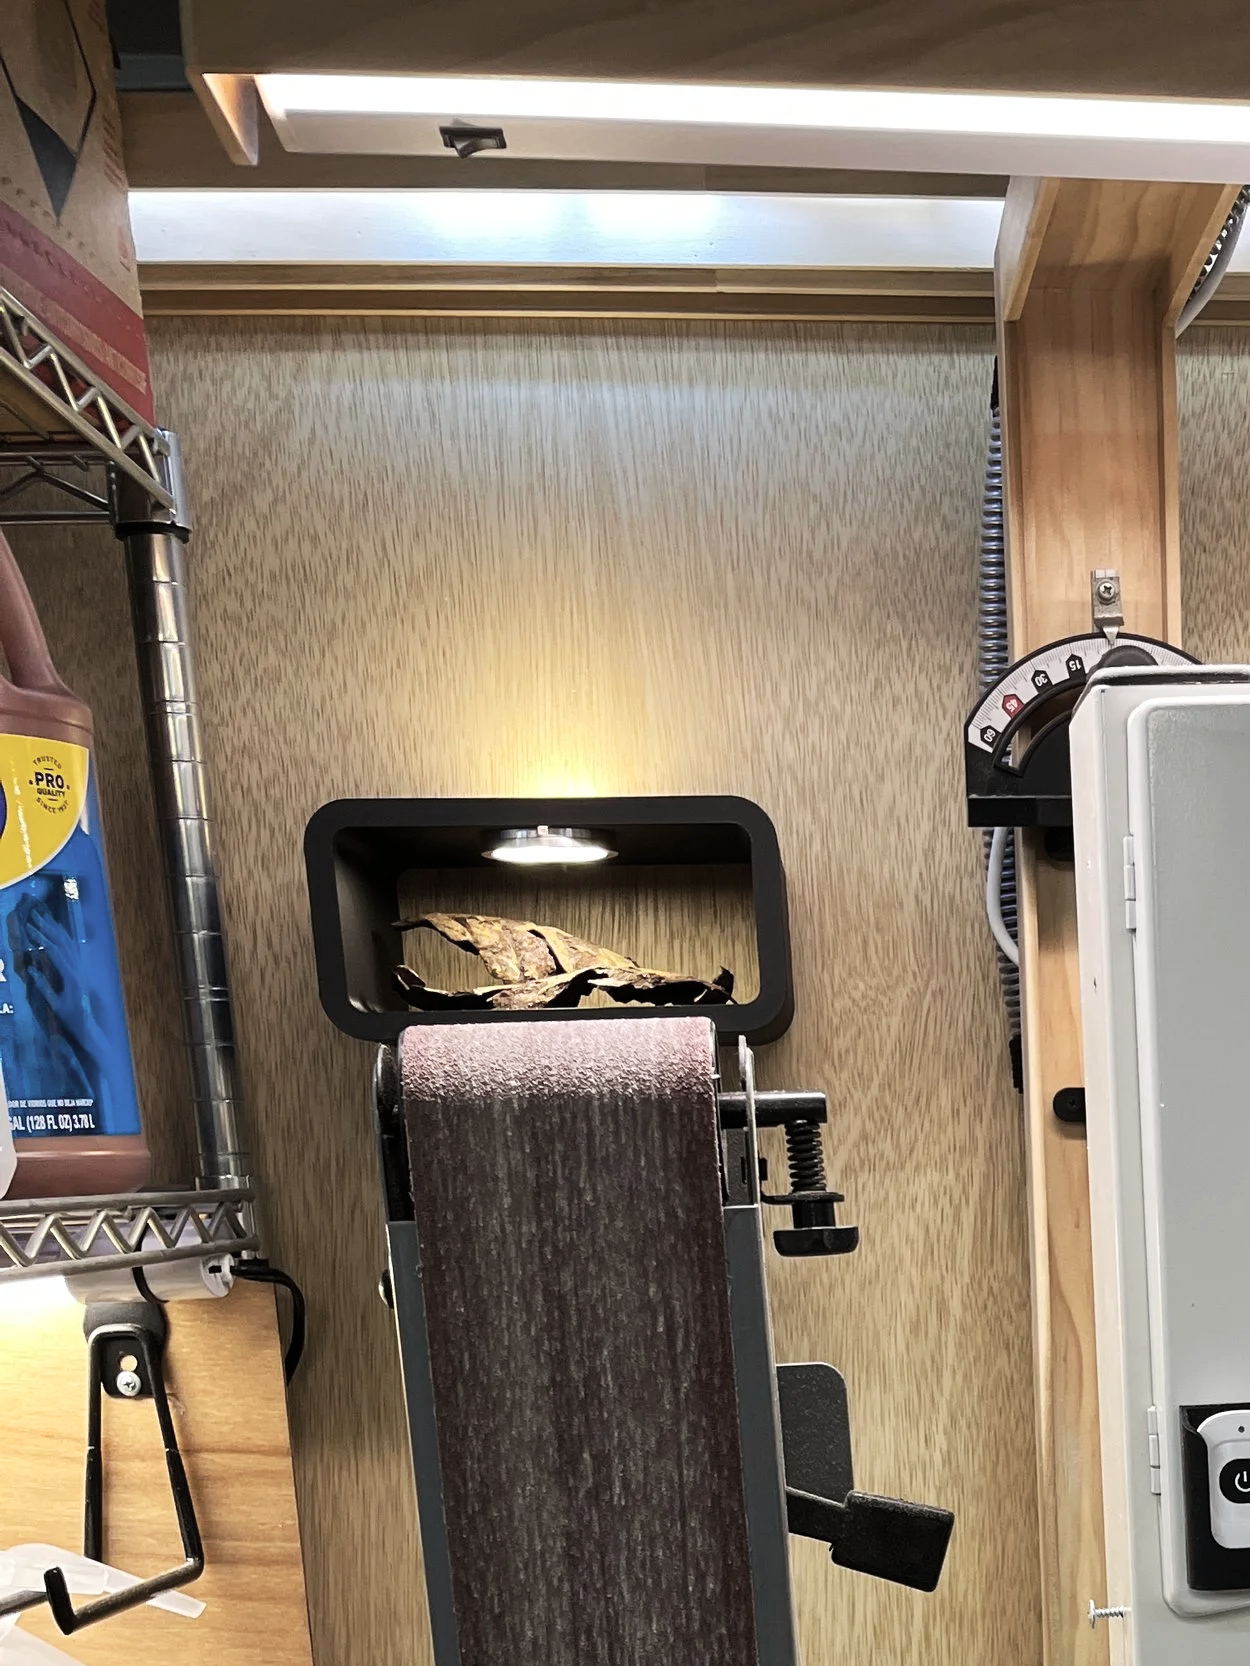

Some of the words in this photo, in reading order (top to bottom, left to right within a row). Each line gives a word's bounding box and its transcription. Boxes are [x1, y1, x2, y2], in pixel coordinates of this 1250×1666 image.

[1068, 659, 1082, 672] 15
[1034, 673, 1048, 687] 30
[1005, 698, 1018, 713] 45
[983, 728, 996, 742] 60
[34, 771, 65, 789] PRO
[37, 788, 65, 797] QUALITY
[26, 1114, 46, 1133] (128
[46, 1113, 58, 1130] FL
[58, 1113, 72, 1132] OZ)
